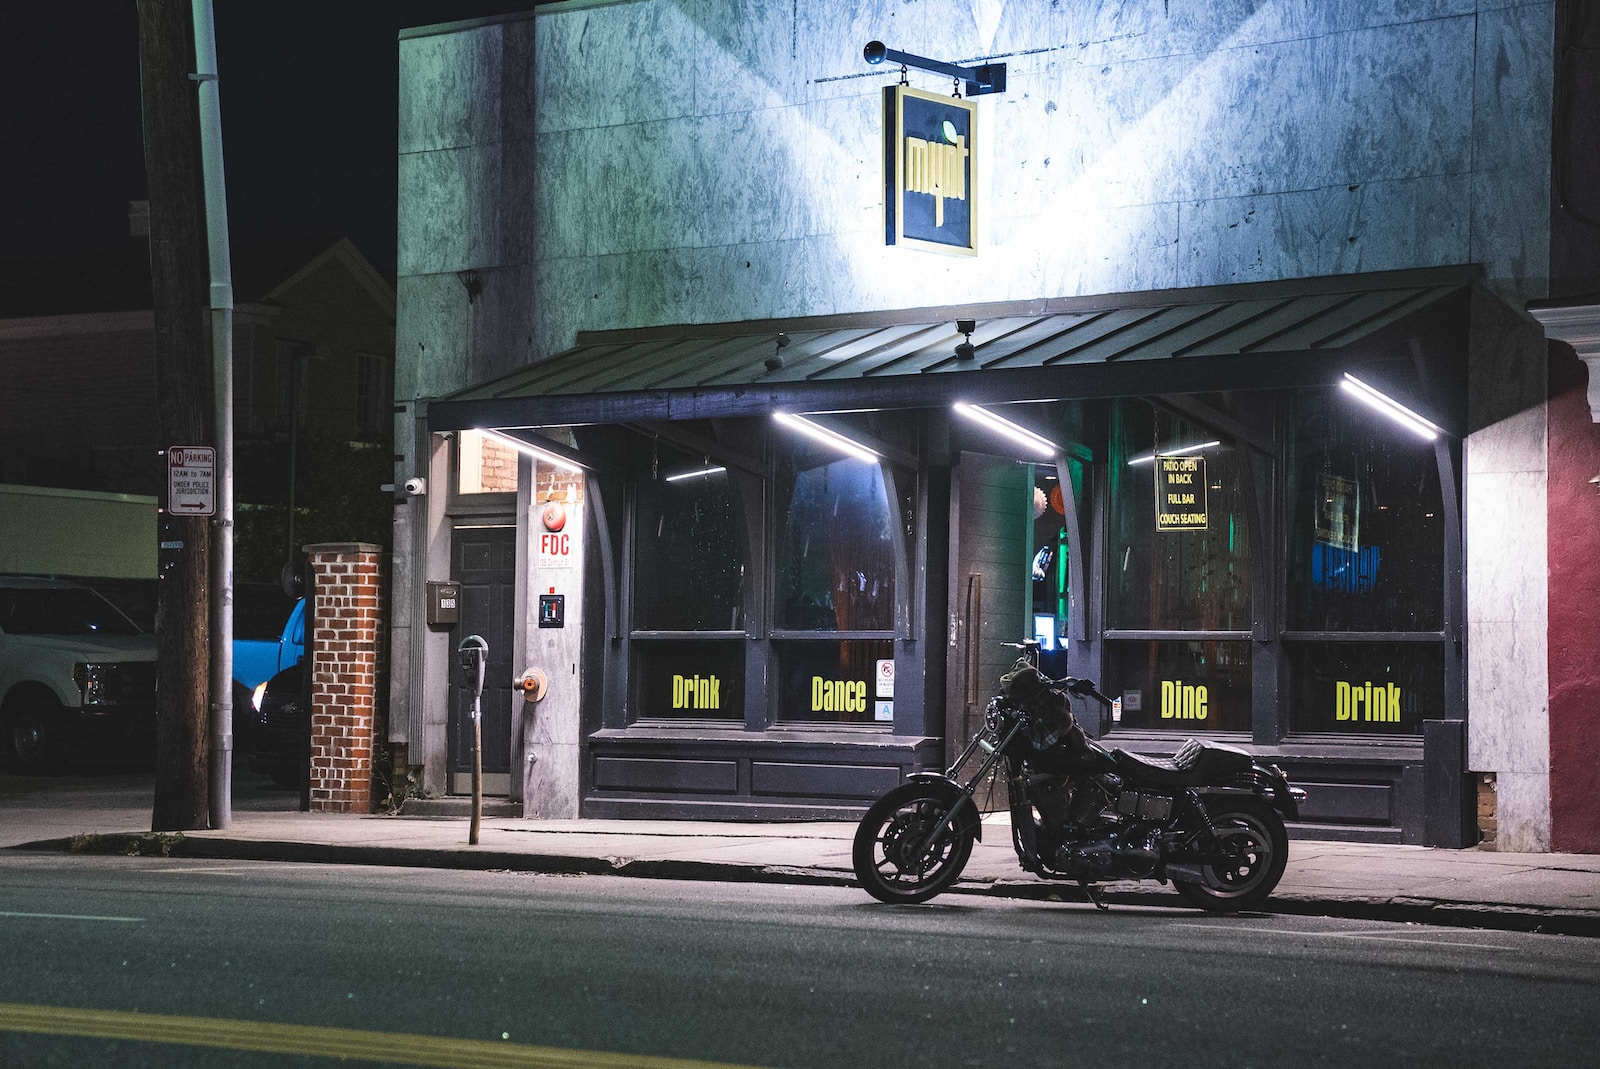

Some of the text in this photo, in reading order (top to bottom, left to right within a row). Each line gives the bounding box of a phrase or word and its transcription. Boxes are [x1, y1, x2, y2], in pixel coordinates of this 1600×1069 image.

[171, 451, 212, 464] NO PARKING
[1163, 460, 1198, 471] PATIO OPEN
[173, 470, 211, 478] 12AM to 7AM
[1168, 473, 1193, 484] IN BACK
[1167, 493, 1195, 504] FULL BAR
[1160, 513, 1206, 524] COUCH SEATING
[541, 534, 569, 556] FDC
[672, 674, 720, 709] Drink
[811, 676, 867, 712] Dance
[1161, 680, 1208, 720] Dine
[1336, 681, 1401, 723] Drink
[882, 705, 890, 715] A
